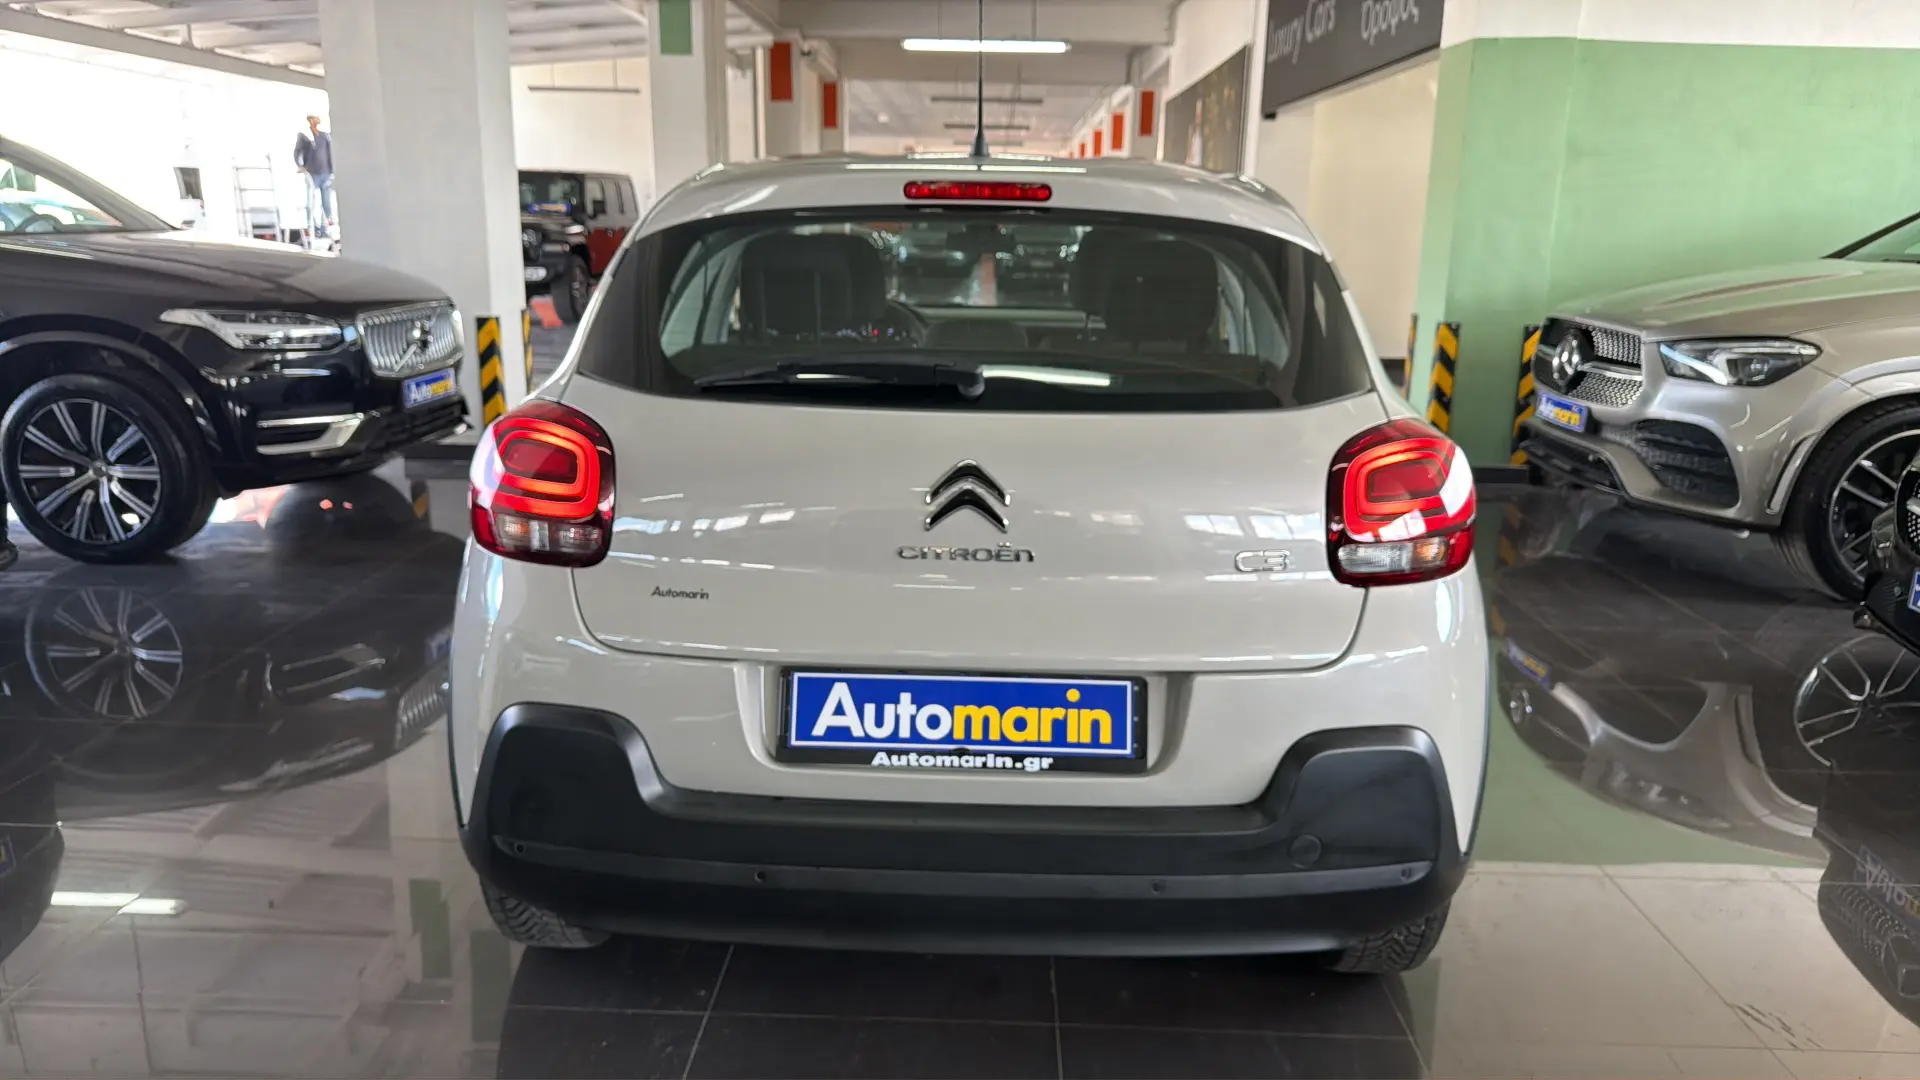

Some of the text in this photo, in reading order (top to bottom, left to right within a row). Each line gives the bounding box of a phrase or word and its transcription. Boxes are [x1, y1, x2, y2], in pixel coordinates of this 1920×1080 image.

[1267, 0, 1336, 64] Luxury Cars
[1234, 550, 1289, 572] C3
[650, 585, 710, 600] Automarin
[811, 682, 1112, 744] Automarin
[871, 751, 1053, 772] Automarin.gr
